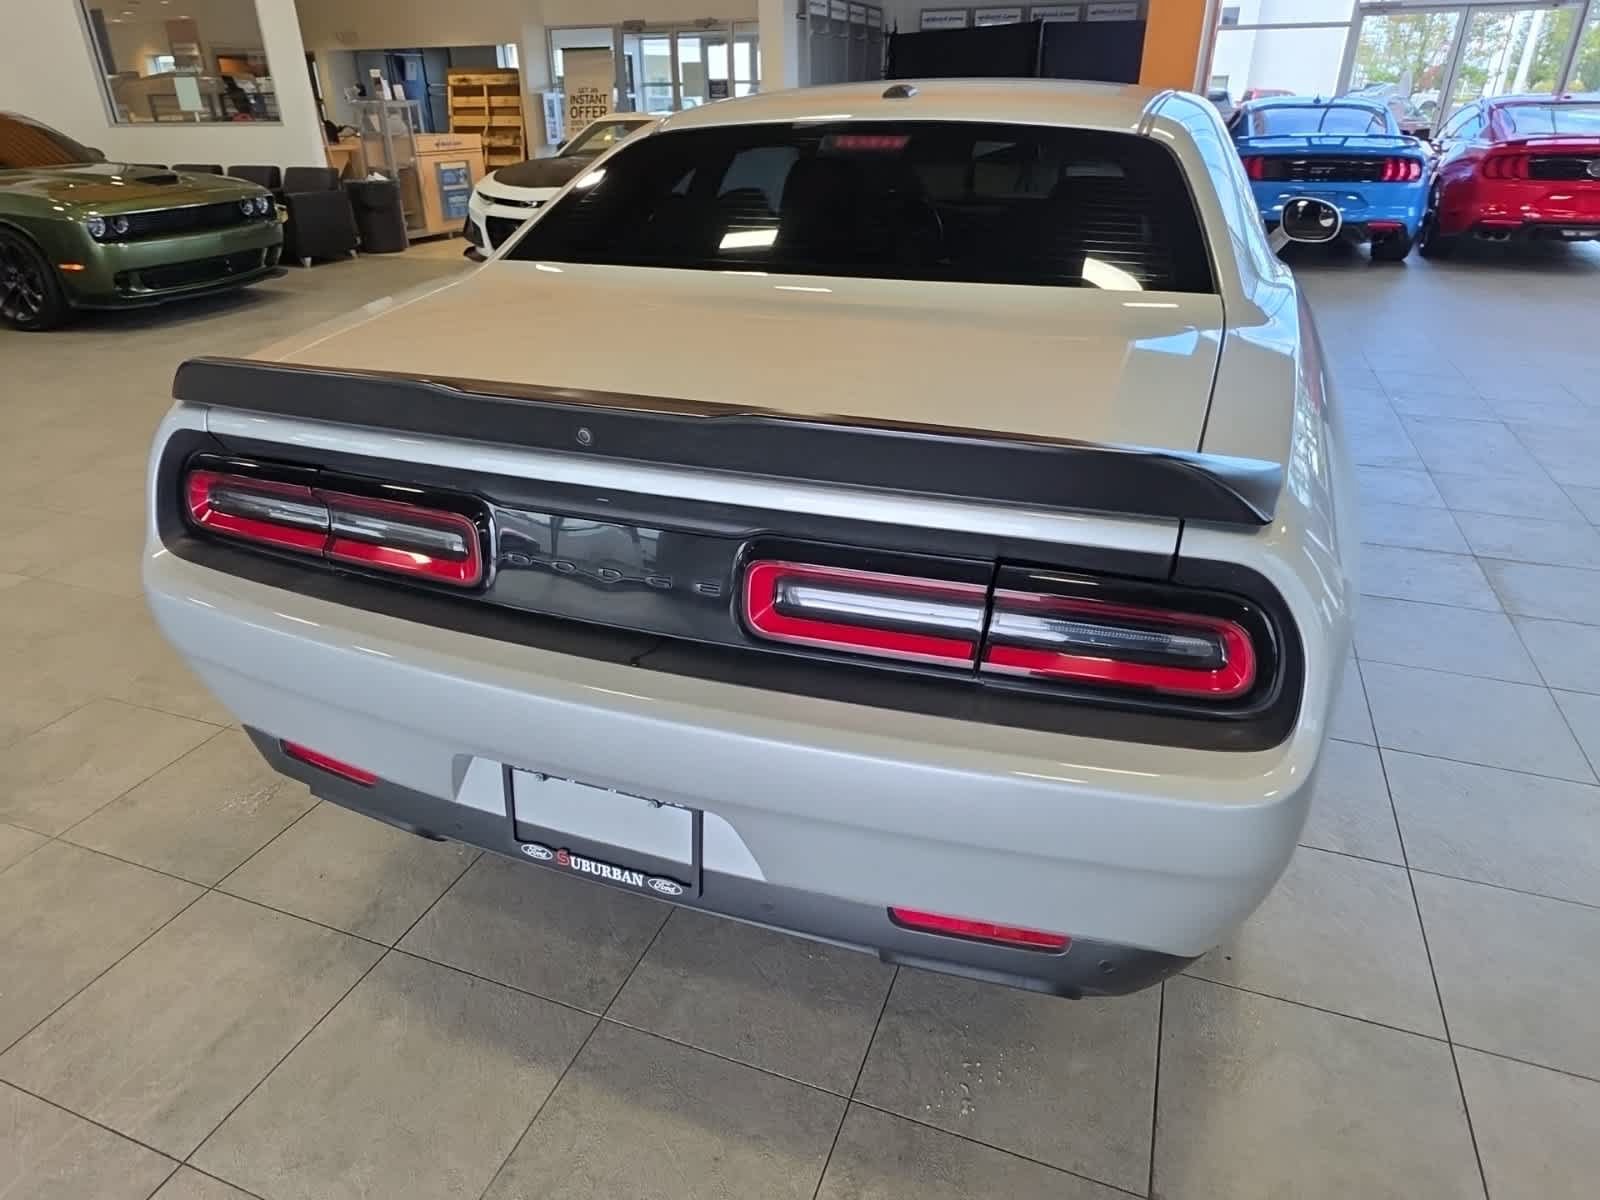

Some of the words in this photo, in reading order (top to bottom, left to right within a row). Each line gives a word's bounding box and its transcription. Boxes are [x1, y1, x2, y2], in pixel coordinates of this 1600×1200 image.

[570, 94, 607, 105] INSTANT
[570, 105, 608, 119] OFFER
[507, 551, 721, 597] DODGE
[525, 845, 549, 860] Ford
[556, 848, 644, 888] SUBURBAN
[653, 879, 679, 895] Ford
